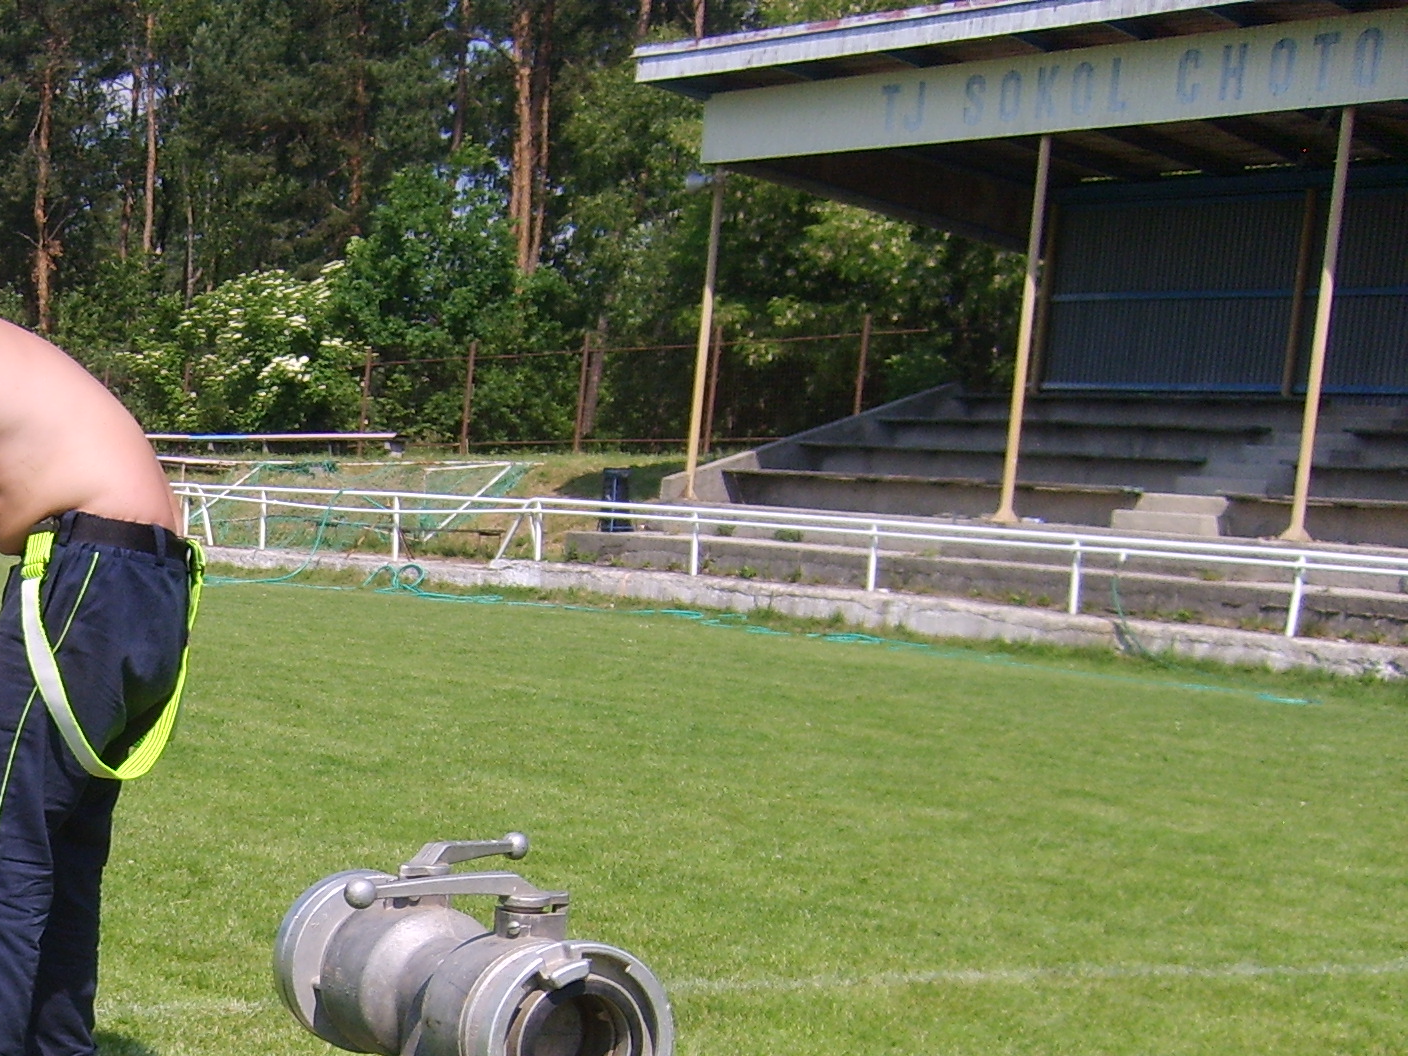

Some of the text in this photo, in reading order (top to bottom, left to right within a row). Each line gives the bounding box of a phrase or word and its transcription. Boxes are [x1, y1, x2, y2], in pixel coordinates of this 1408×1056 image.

[882, 27, 1385, 133] TJ SOKOL CHOTO
